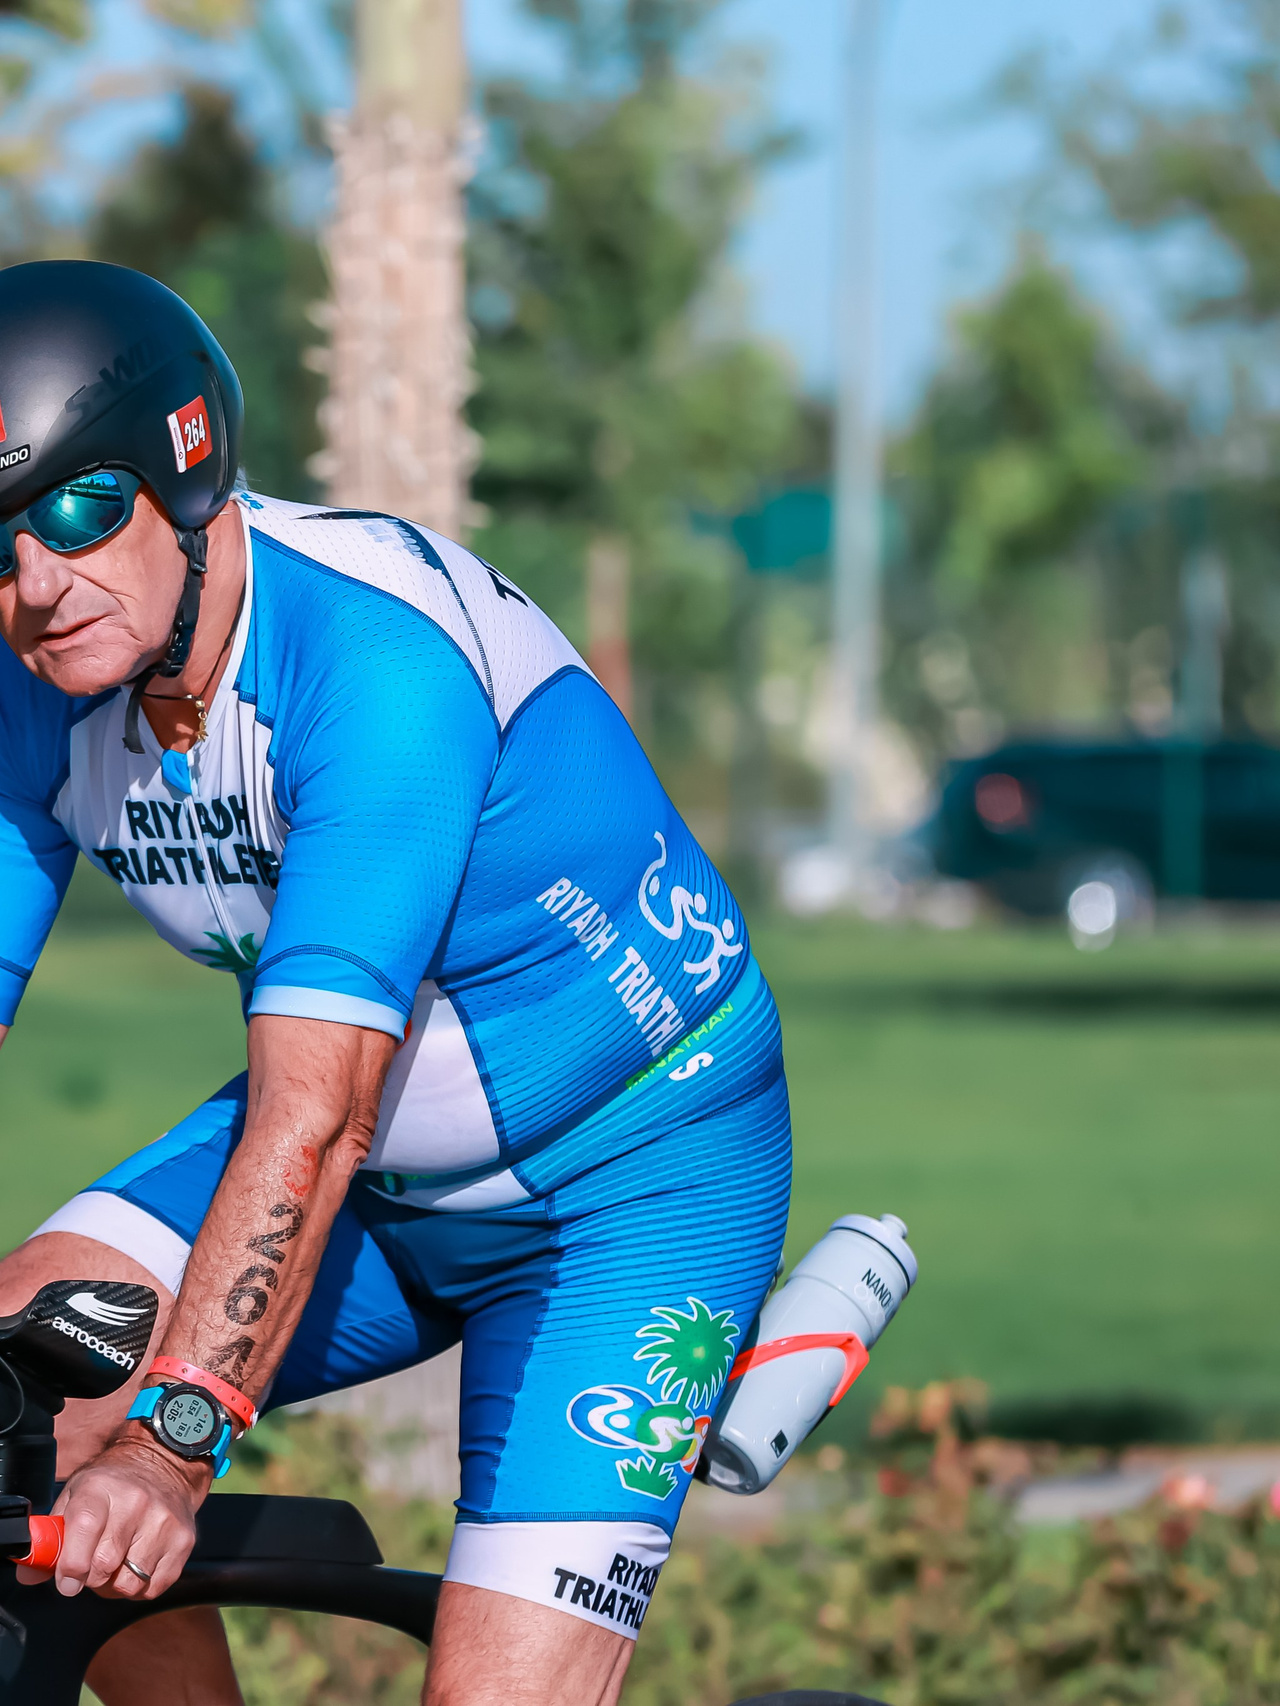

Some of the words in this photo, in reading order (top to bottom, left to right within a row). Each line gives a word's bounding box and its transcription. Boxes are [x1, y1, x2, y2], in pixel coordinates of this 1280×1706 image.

[184, 413, 206, 452] 264
[535, 877, 619, 962] RIYADH
[861, 1267, 892, 1308] NANO
[51, 1315, 136, 1371] aerocoach
[554, 1567, 649, 1631] TRIATHL
